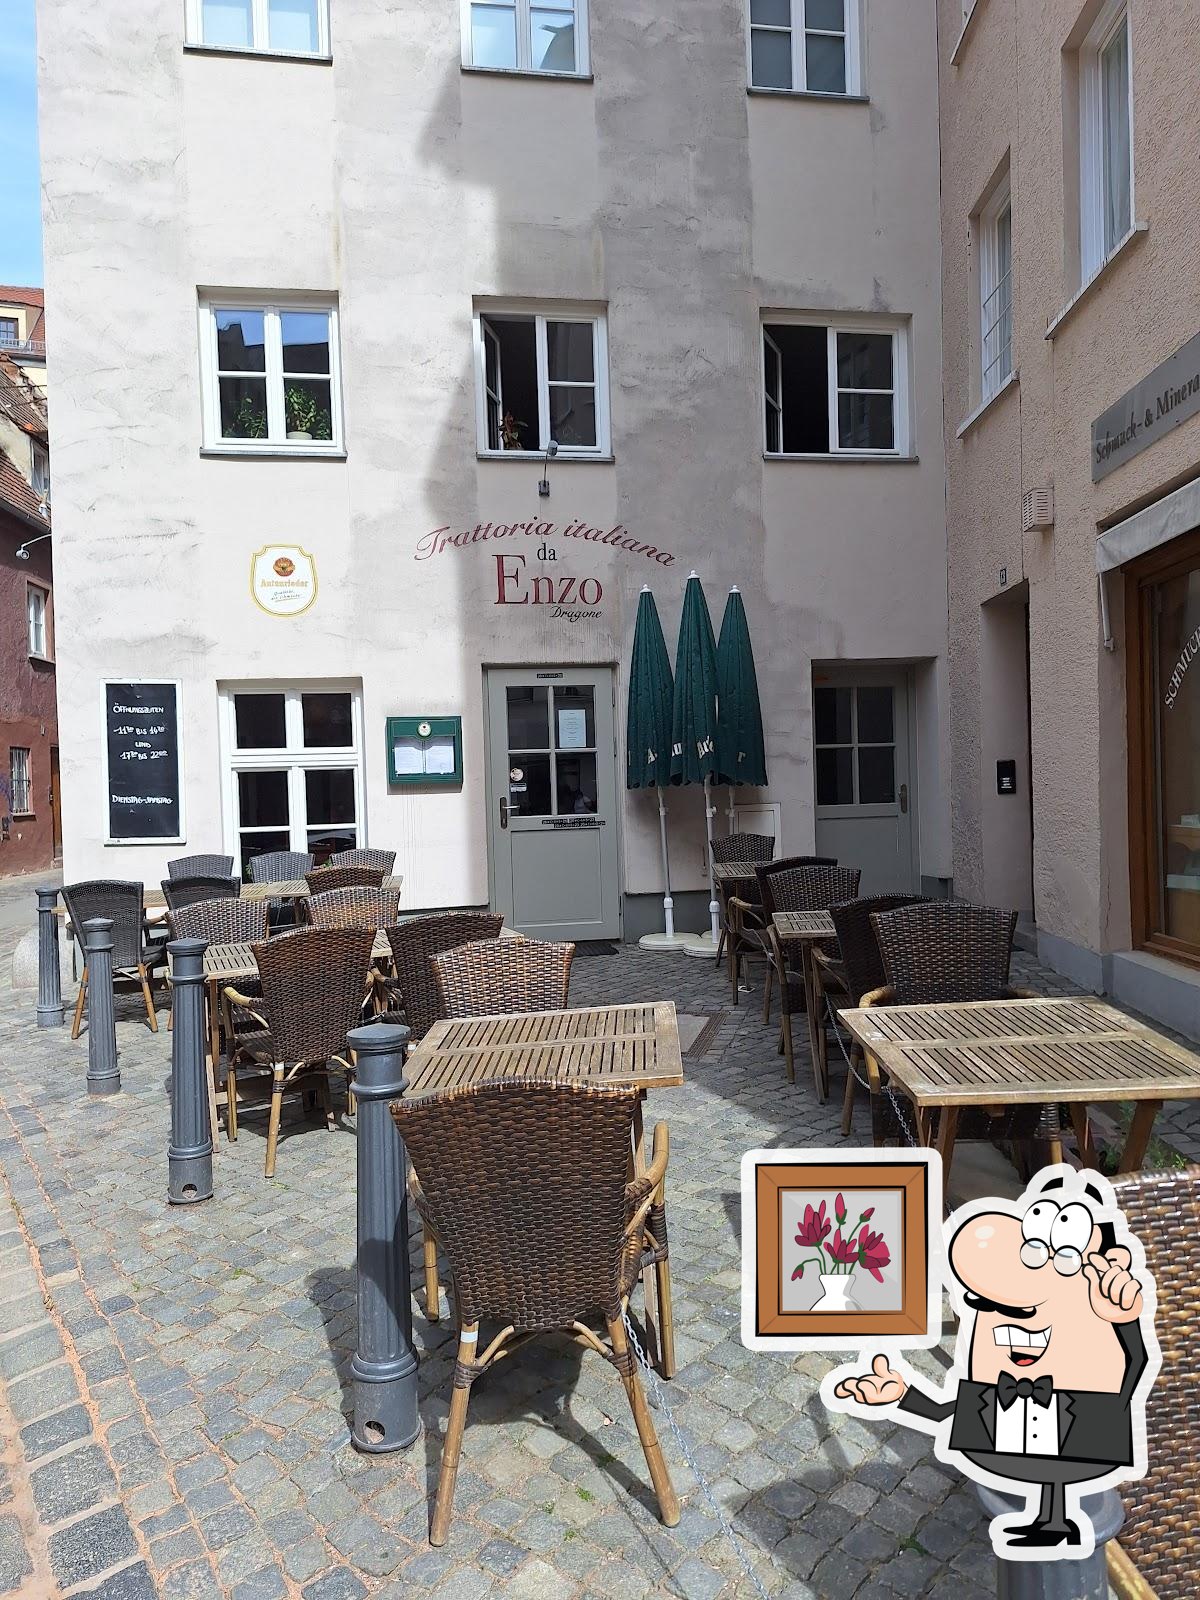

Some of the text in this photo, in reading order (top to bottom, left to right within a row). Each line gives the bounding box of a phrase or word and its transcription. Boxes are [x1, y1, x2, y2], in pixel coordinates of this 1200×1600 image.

[1096, 411, 1142, 463] Schmuck-
[1144, 408, 1153, 428] &
[414, 516, 678, 567] Trattoria italiana
[537, 543, 557, 561] da
[492, 554, 603, 605] Enzo
[549, 605, 602, 623] Dragone
